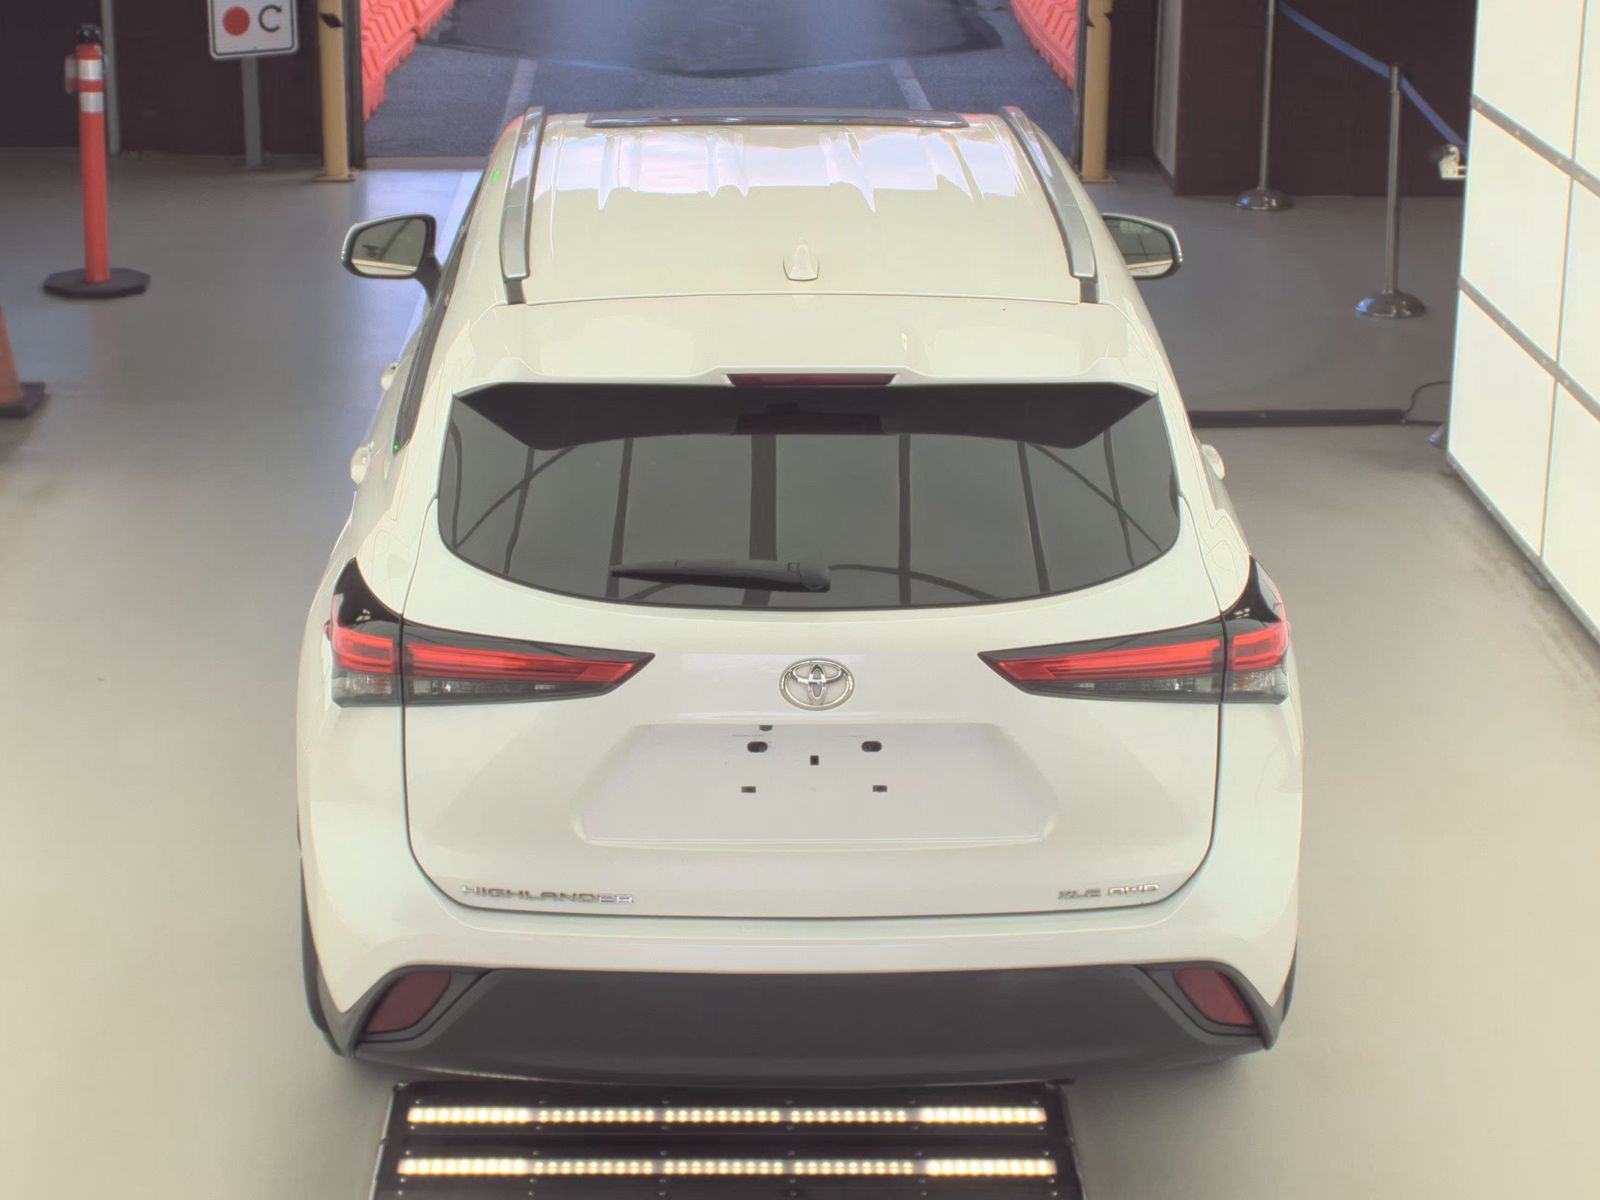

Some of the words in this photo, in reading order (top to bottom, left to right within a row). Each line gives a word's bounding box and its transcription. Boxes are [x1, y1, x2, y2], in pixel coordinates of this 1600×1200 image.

[258, 4, 282, 33] C
[462, 886, 633, 903] HIGHLANDER
[1058, 889, 1101, 899] XLE
[1108, 884, 1159, 896] AWD
